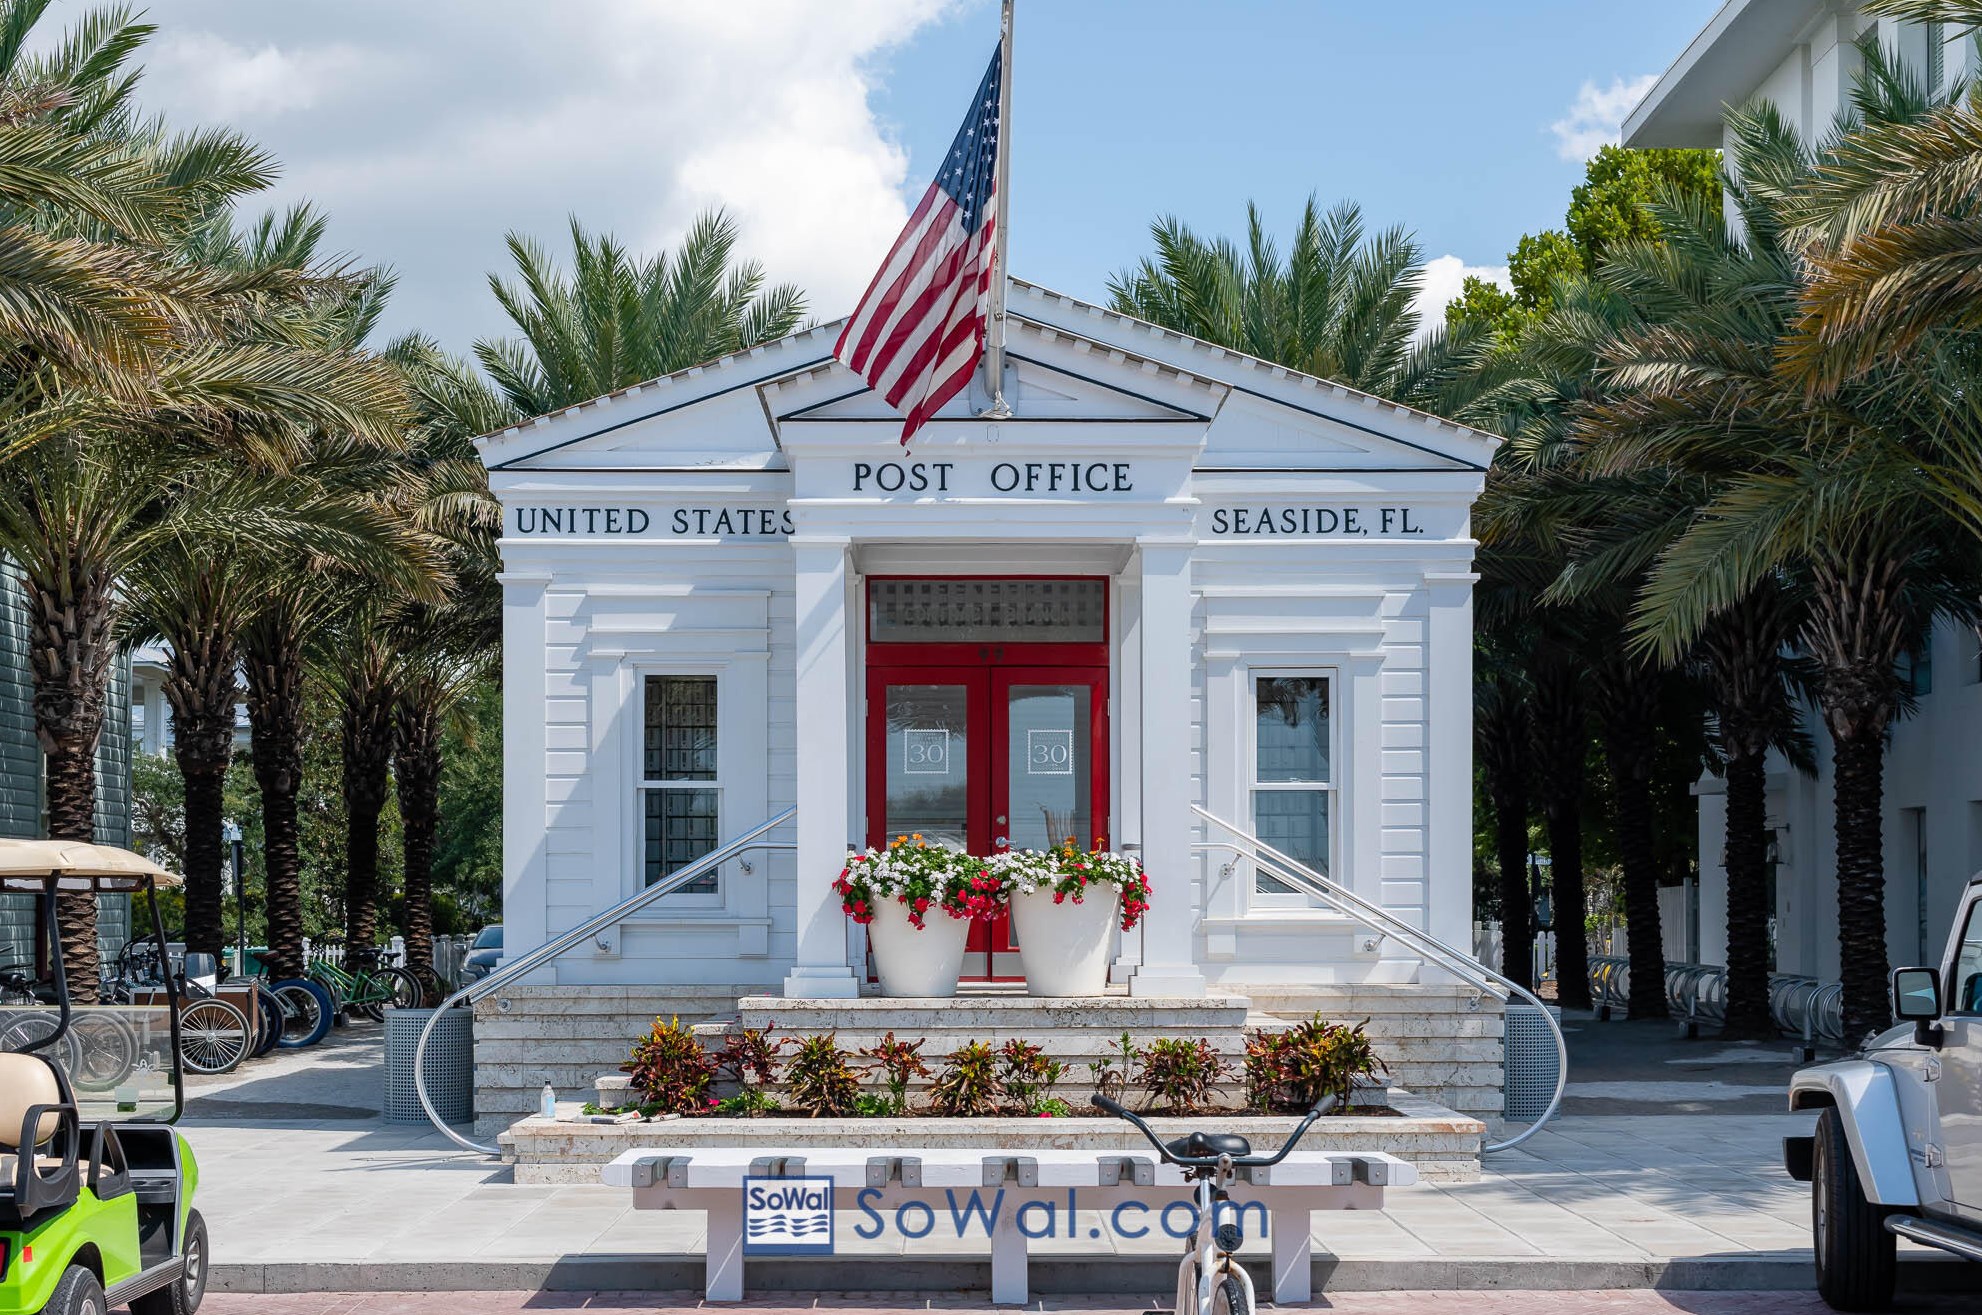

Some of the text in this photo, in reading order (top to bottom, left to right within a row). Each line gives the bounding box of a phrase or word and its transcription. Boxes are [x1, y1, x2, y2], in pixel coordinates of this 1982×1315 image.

[852, 463, 1133, 492] POST OFFICE
[515, 507, 796, 535] UNITED STATES
[1211, 507, 1424, 537] SEASIDE, FL.
[909, 744, 944, 764] 30
[1032, 744, 1067, 764] 30
